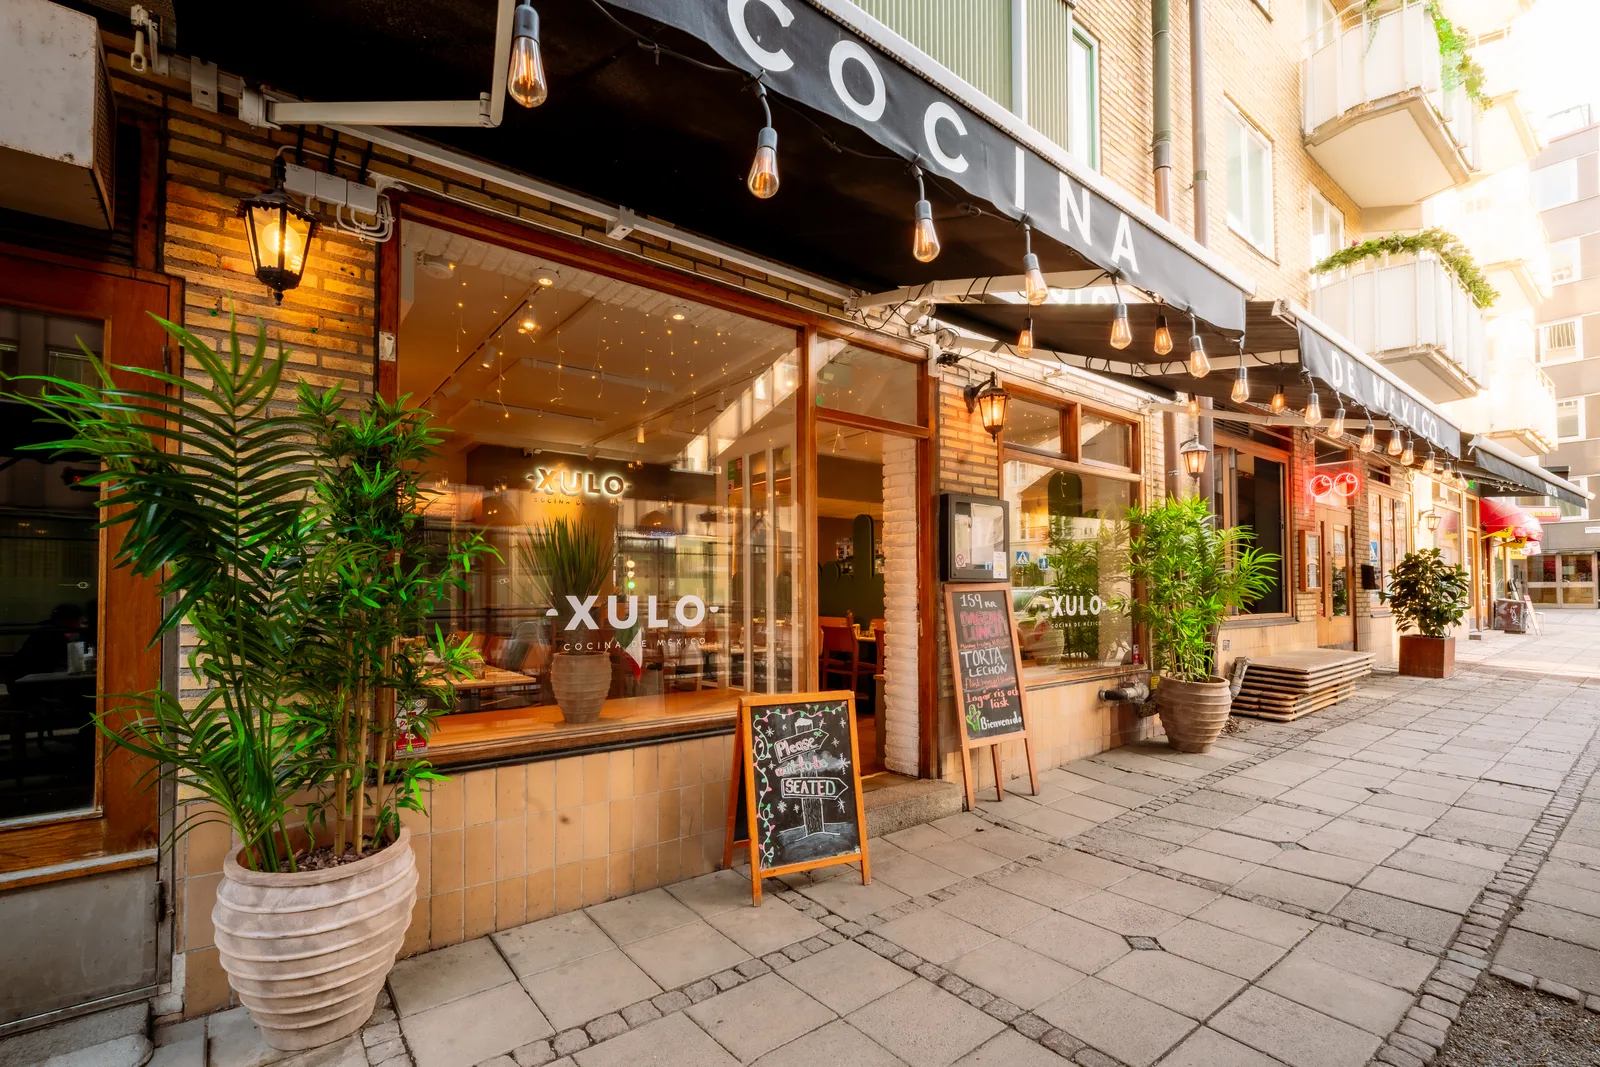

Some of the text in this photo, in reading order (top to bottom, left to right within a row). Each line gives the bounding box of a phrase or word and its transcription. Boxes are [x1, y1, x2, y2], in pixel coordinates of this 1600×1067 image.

[728, 0, 1139, 274] COCINA
[1331, 350, 1356, 396] DE
[537, 467, 625, 496] XULO
[959, 593, 983, 609] 159
[1051, 594, 1101, 617] XULO
[564, 594, 706, 631] XULO
[1051, 621, 1072, 629] COCINA
[563, 640, 622, 651] COCINA
[961, 646, 1006, 669] TORTA
[968, 662, 1008, 678] LECHÓN
[993, 688, 1005, 698] ris
[1007, 686, 1019, 696] och
[990, 697, 1010, 709] läsk
[775, 737, 819, 757] Please
[796, 755, 812, 773] to
[812, 755, 829, 770] be
[785, 779, 836, 796] SEATED
